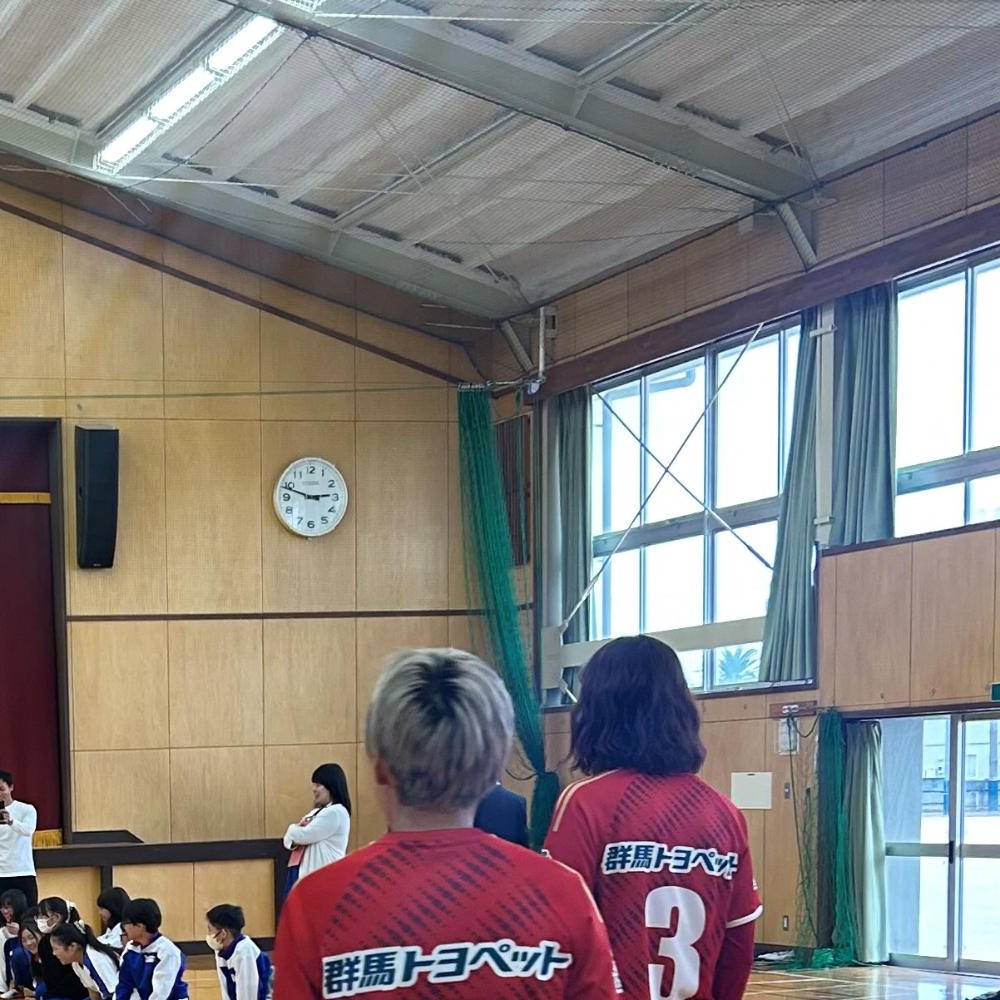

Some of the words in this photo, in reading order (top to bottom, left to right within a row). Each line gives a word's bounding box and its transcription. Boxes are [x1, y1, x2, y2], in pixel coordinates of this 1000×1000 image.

[306, 466, 315, 474] 12
[321, 469, 325, 477] 1
[294, 471, 302, 479] 11
[328, 480, 335, 488] 2
[283, 493, 290, 501] 9
[332, 493, 339, 501] 3
[286, 506, 293, 514] 8
[297, 517, 303, 525] 7
[604, 844, 738, 877] 群馬トヨペット
[324, 941, 571, 997] 群馬トヨペット
